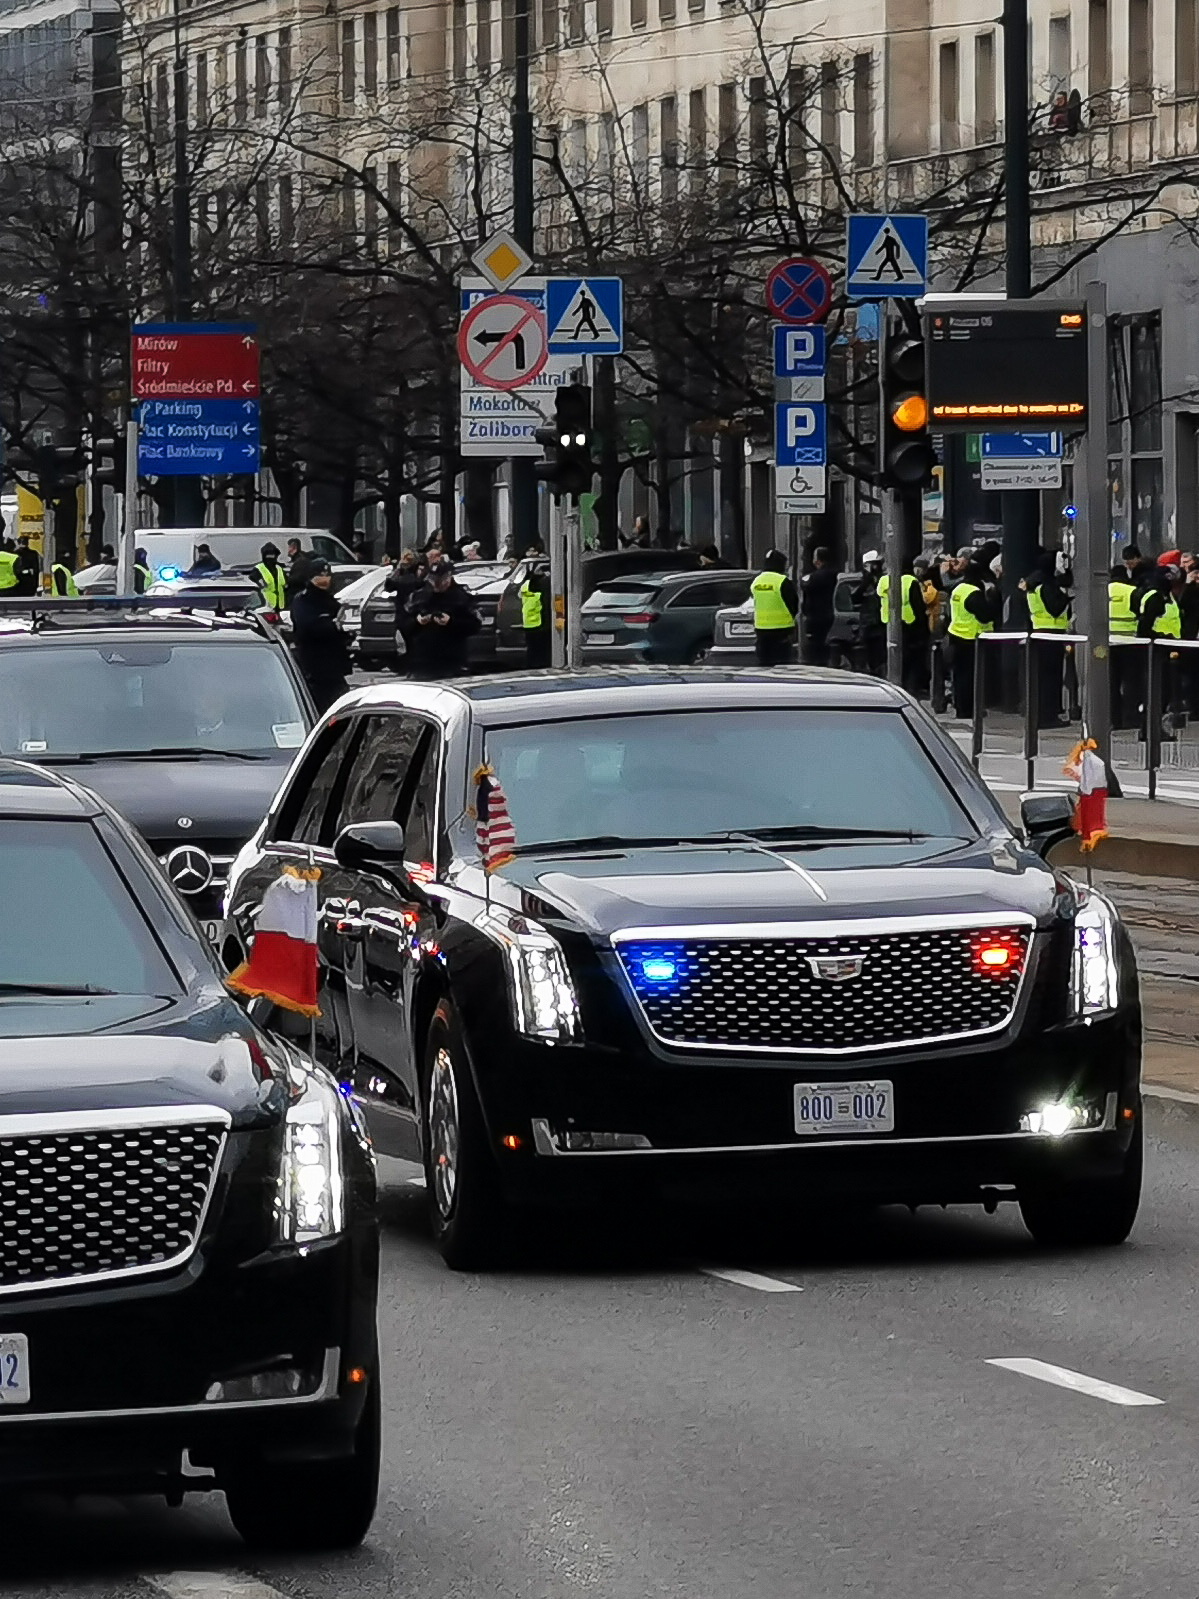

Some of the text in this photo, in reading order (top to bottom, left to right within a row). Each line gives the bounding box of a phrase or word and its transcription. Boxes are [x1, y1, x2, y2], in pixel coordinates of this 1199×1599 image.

[786, 331, 814, 370] P
[137, 358, 169, 375] Filtry
[155, 402, 202, 419] Parking
[145, 422, 238, 440] lac Konstytucji
[787, 407, 815, 447] P
[801, 1094, 886, 1120] 800 002
